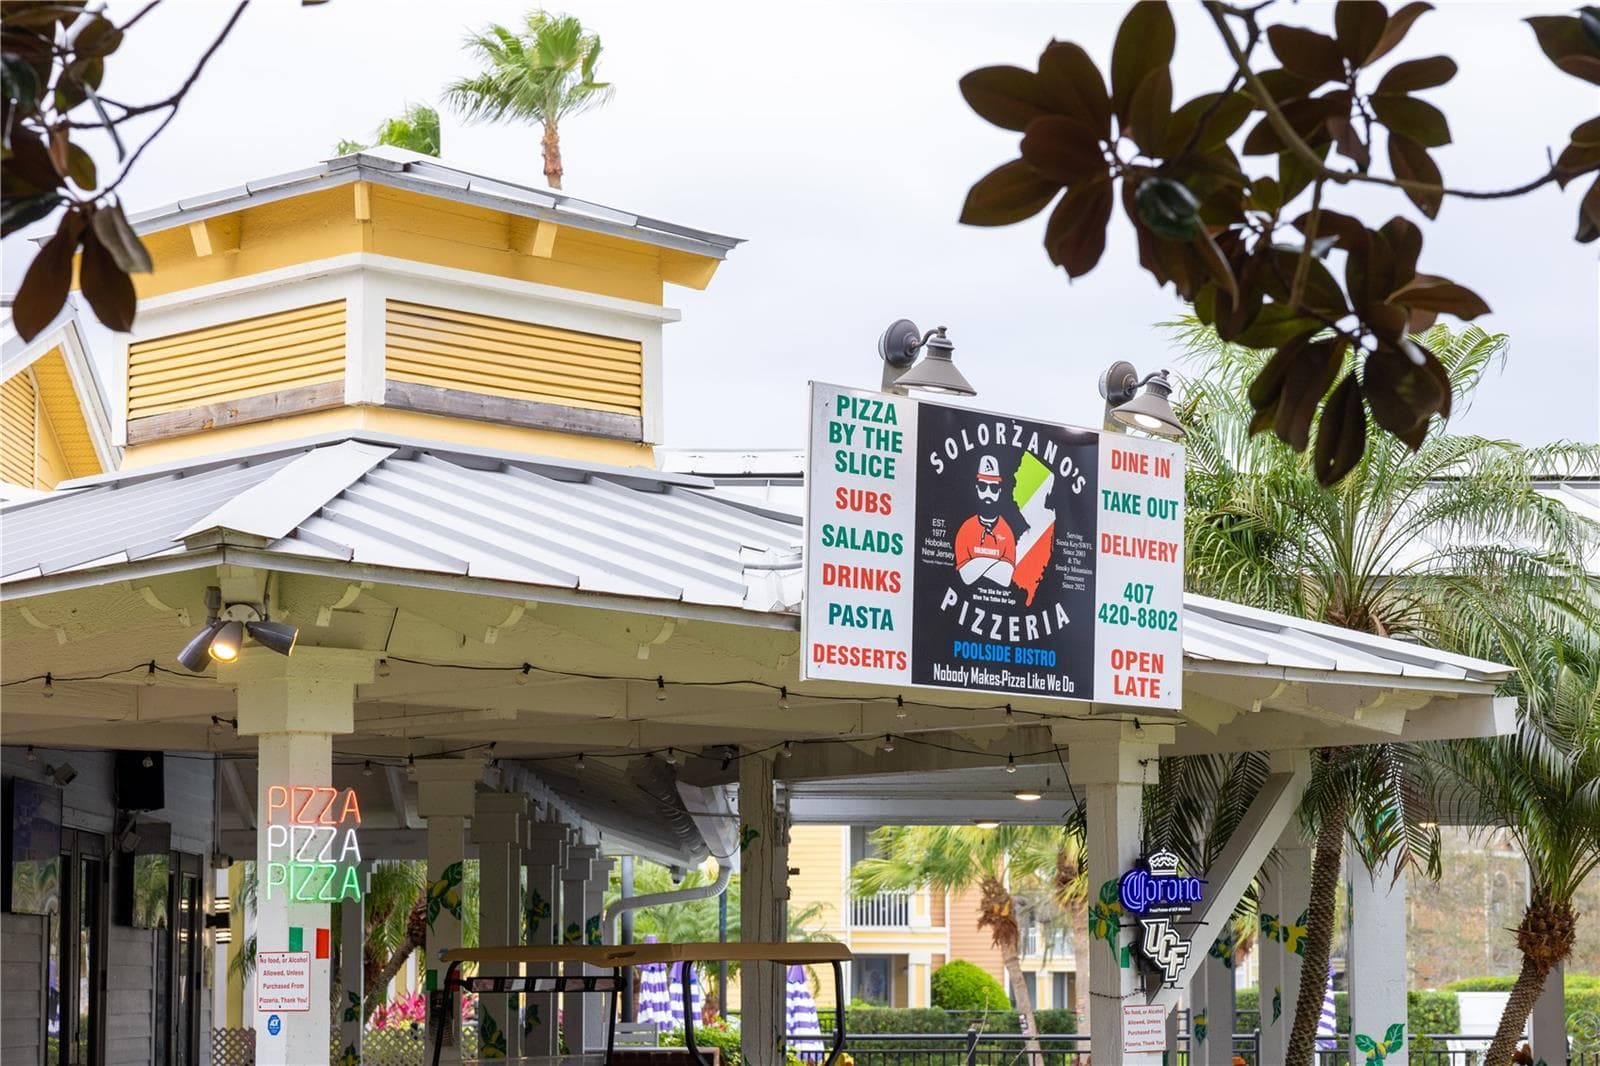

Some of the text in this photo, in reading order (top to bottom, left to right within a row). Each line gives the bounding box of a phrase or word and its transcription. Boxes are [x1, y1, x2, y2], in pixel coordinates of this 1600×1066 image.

[837, 394, 898, 425] PIZZA
[828, 421, 903, 454] BY THE
[835, 449, 896, 480] SLICE
[929, 421, 1087, 494] SOLORZANO'S
[1111, 449, 1170, 478] DINE IN
[835, 486, 892, 516] SUBS
[1102, 489, 1179, 521] TAKE OUT
[932, 518, 946, 528] EST.
[932, 528, 946, 538] 1977
[821, 523, 904, 556] SALADS
[921, 547, 955, 560] New Jersey
[925, 537, 952, 549] Hoboken,
[1101, 533, 1178, 563] DELIVERY
[823, 563, 901, 594] DRINKS
[1123, 582, 1154, 605] 407
[828, 603, 894, 631] PASTA
[940, 586, 1071, 642] PIZZERIA
[1098, 603, 1178, 632] 420-8802
[813, 643, 907, 671] DESSERTS
[953, 640, 1057, 667] POOLSIDE BISTRO
[1111, 648, 1164, 674] OPEN
[933, 663, 1075, 693] Nobody Makes Pizza Like We Do
[1113, 674, 1161, 699] LATE
[268, 785, 362, 824] PIZZA
[267, 824, 362, 863] PIZZA
[266, 863, 361, 901] PIZZA
[1120, 869, 1202, 913] Corona
[1142, 920, 1191, 981] UCF
